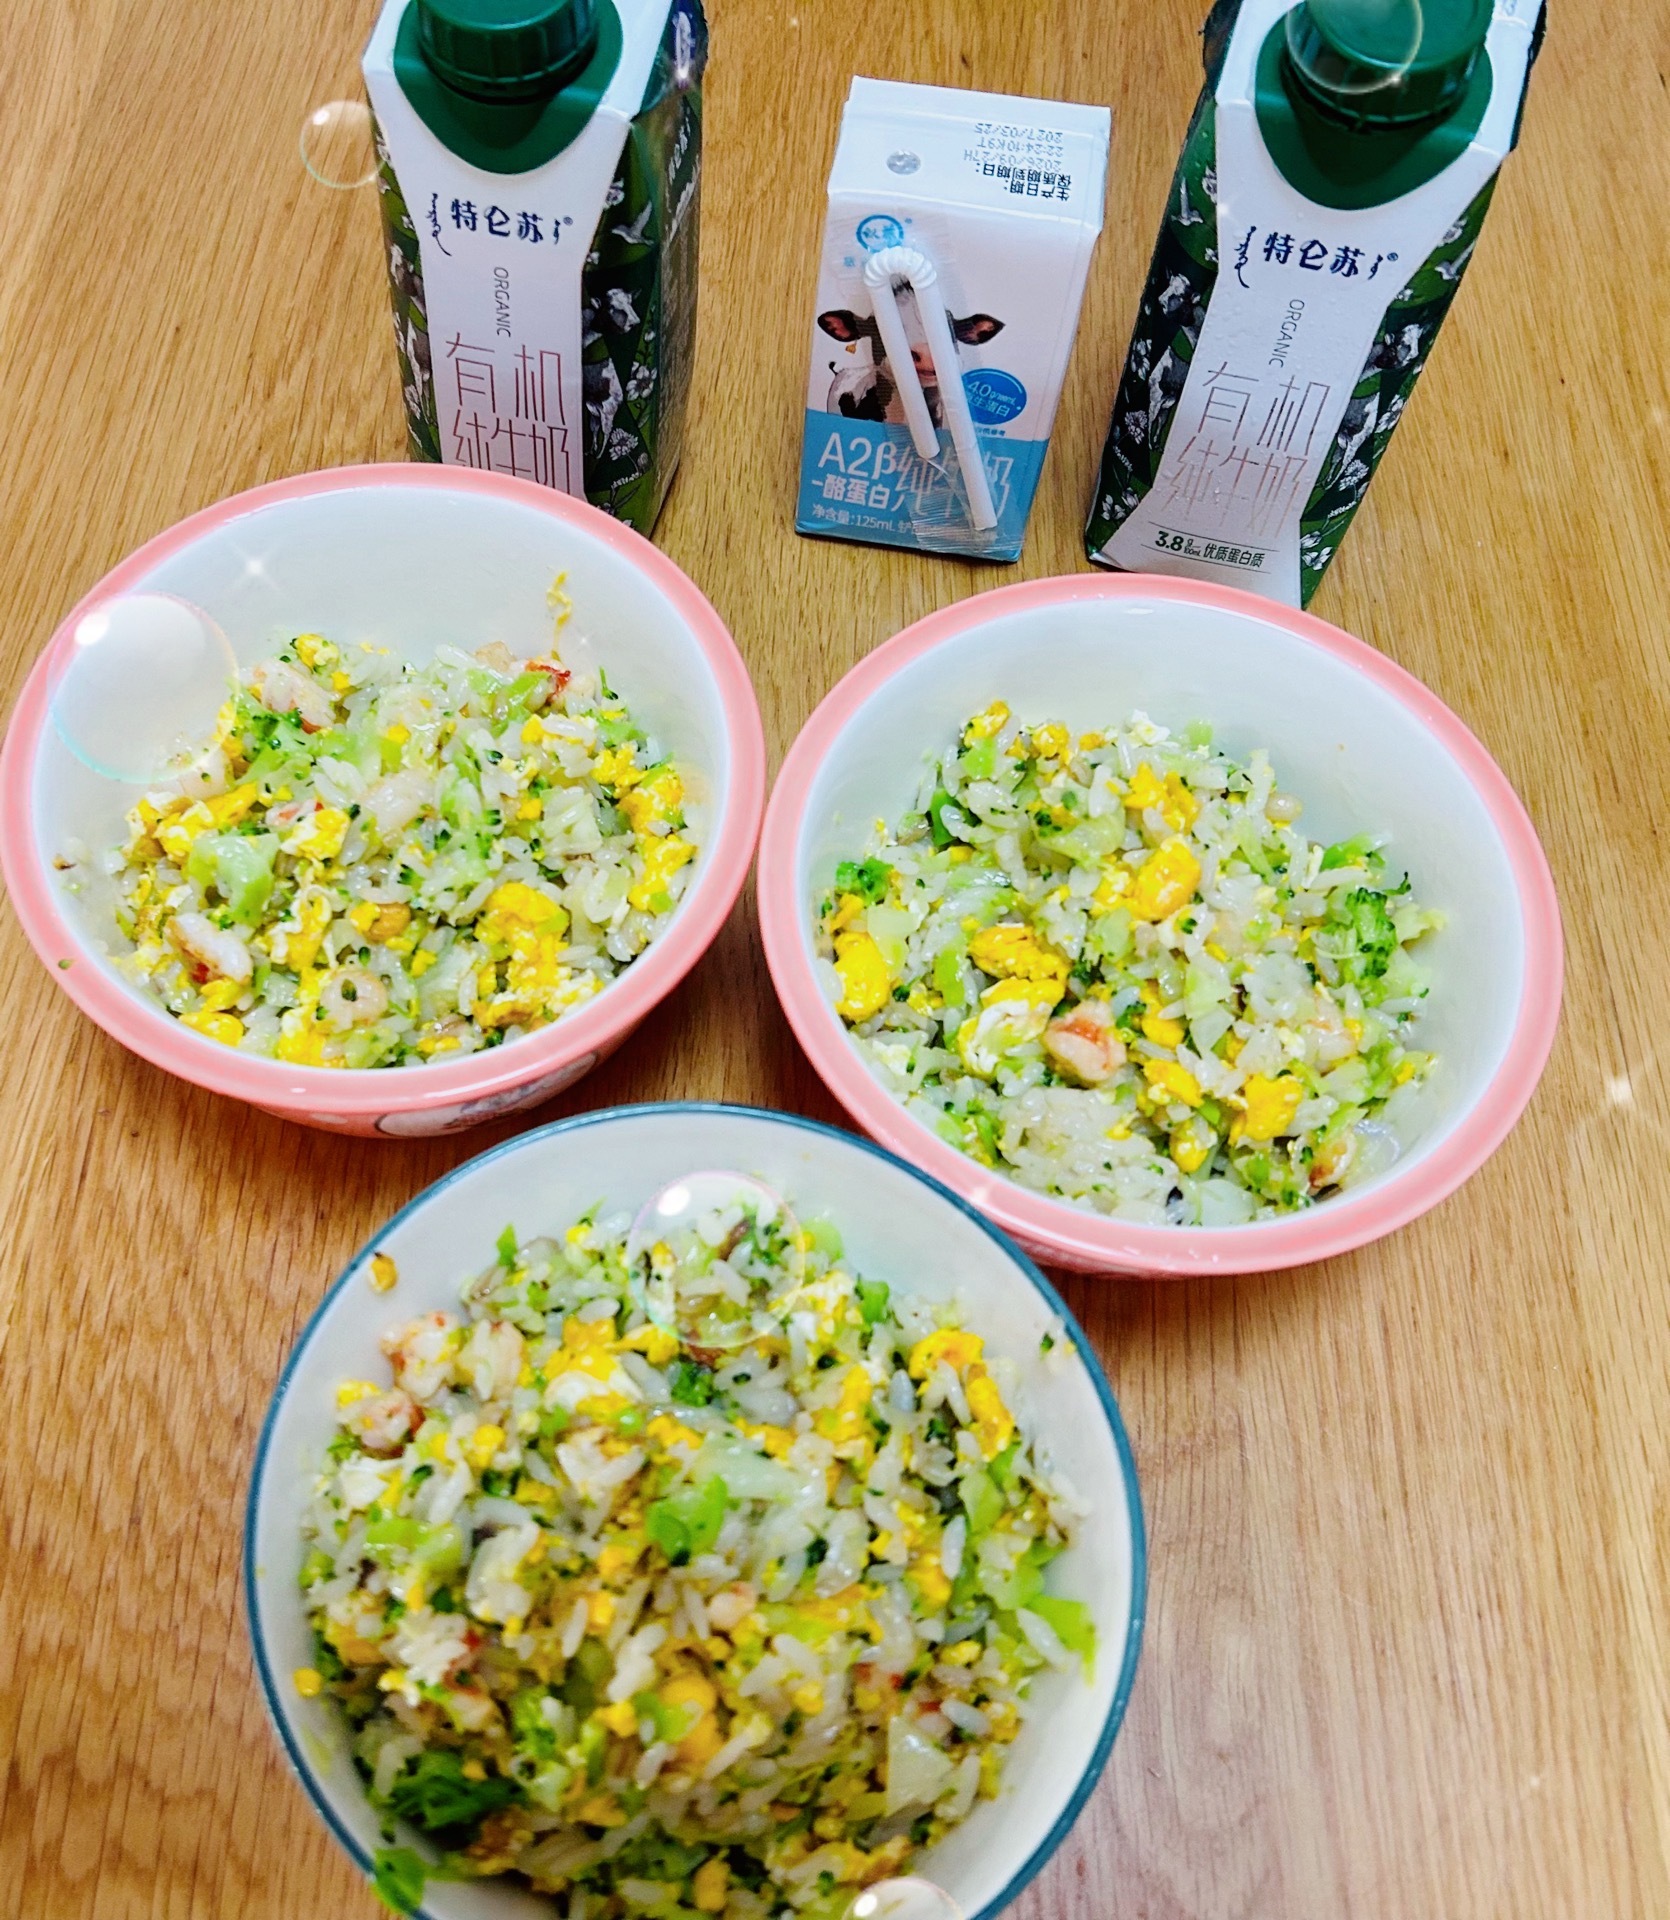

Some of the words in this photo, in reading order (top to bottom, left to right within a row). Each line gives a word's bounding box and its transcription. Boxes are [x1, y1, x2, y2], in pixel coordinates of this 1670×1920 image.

[451, 198, 543, 243] 特仑苏
[1263, 231, 1365, 278] 特仑苏
[493, 266, 512, 338] ORGANIC
[1268, 299, 1305, 368] ORGANIC
[446, 332, 566, 426] 有机
[1198, 361, 1331, 456] 有机
[453, 409, 571, 495] 纯牛奶
[1161, 435, 1308, 538] 纯牛奶
[1155, 530, 1184, 551] 3.8
[1203, 543, 1265, 568] 优质蛋白质
